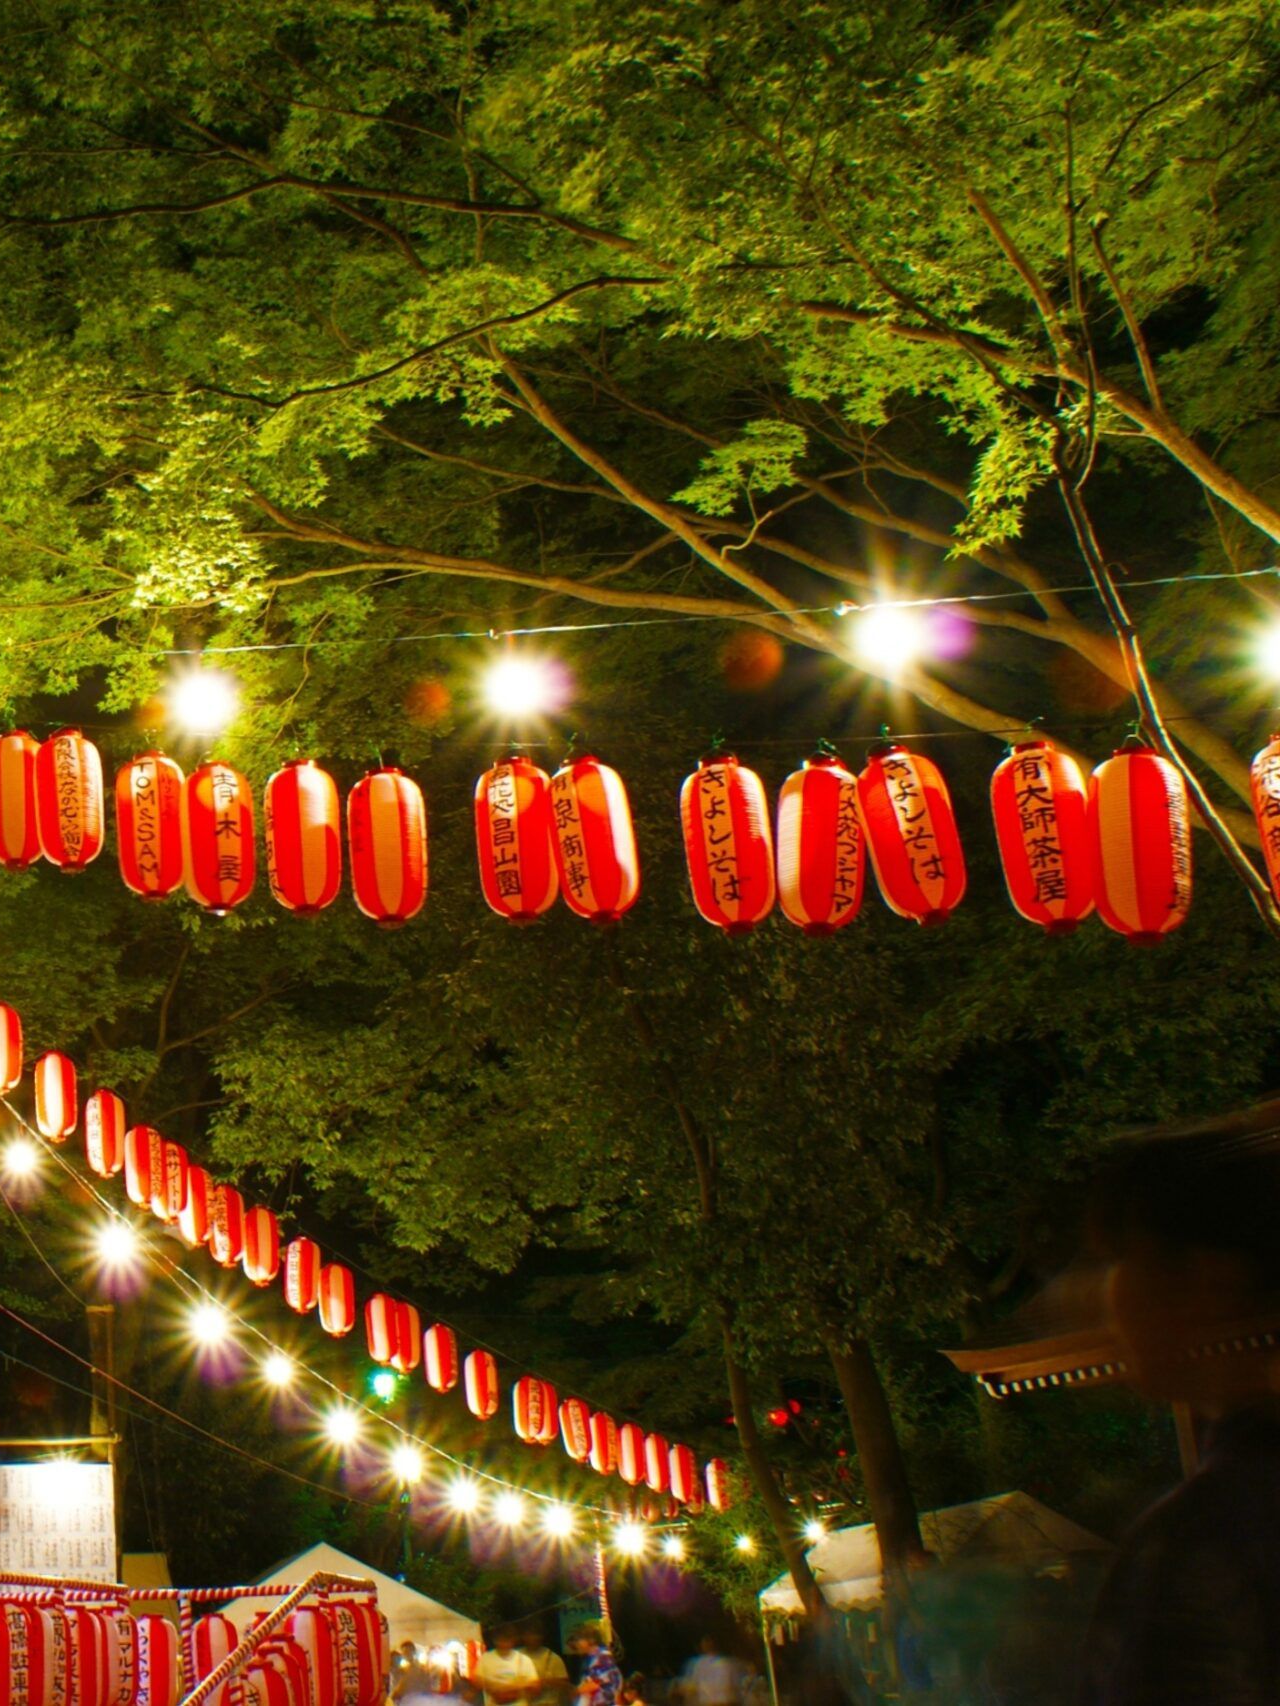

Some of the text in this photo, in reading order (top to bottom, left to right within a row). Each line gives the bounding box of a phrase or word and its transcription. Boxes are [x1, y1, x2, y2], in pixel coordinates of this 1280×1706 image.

[214, 773, 241, 882] 青木屋
[699, 769, 747, 905] きよしそば
[883, 758, 947, 884] きよしそば
